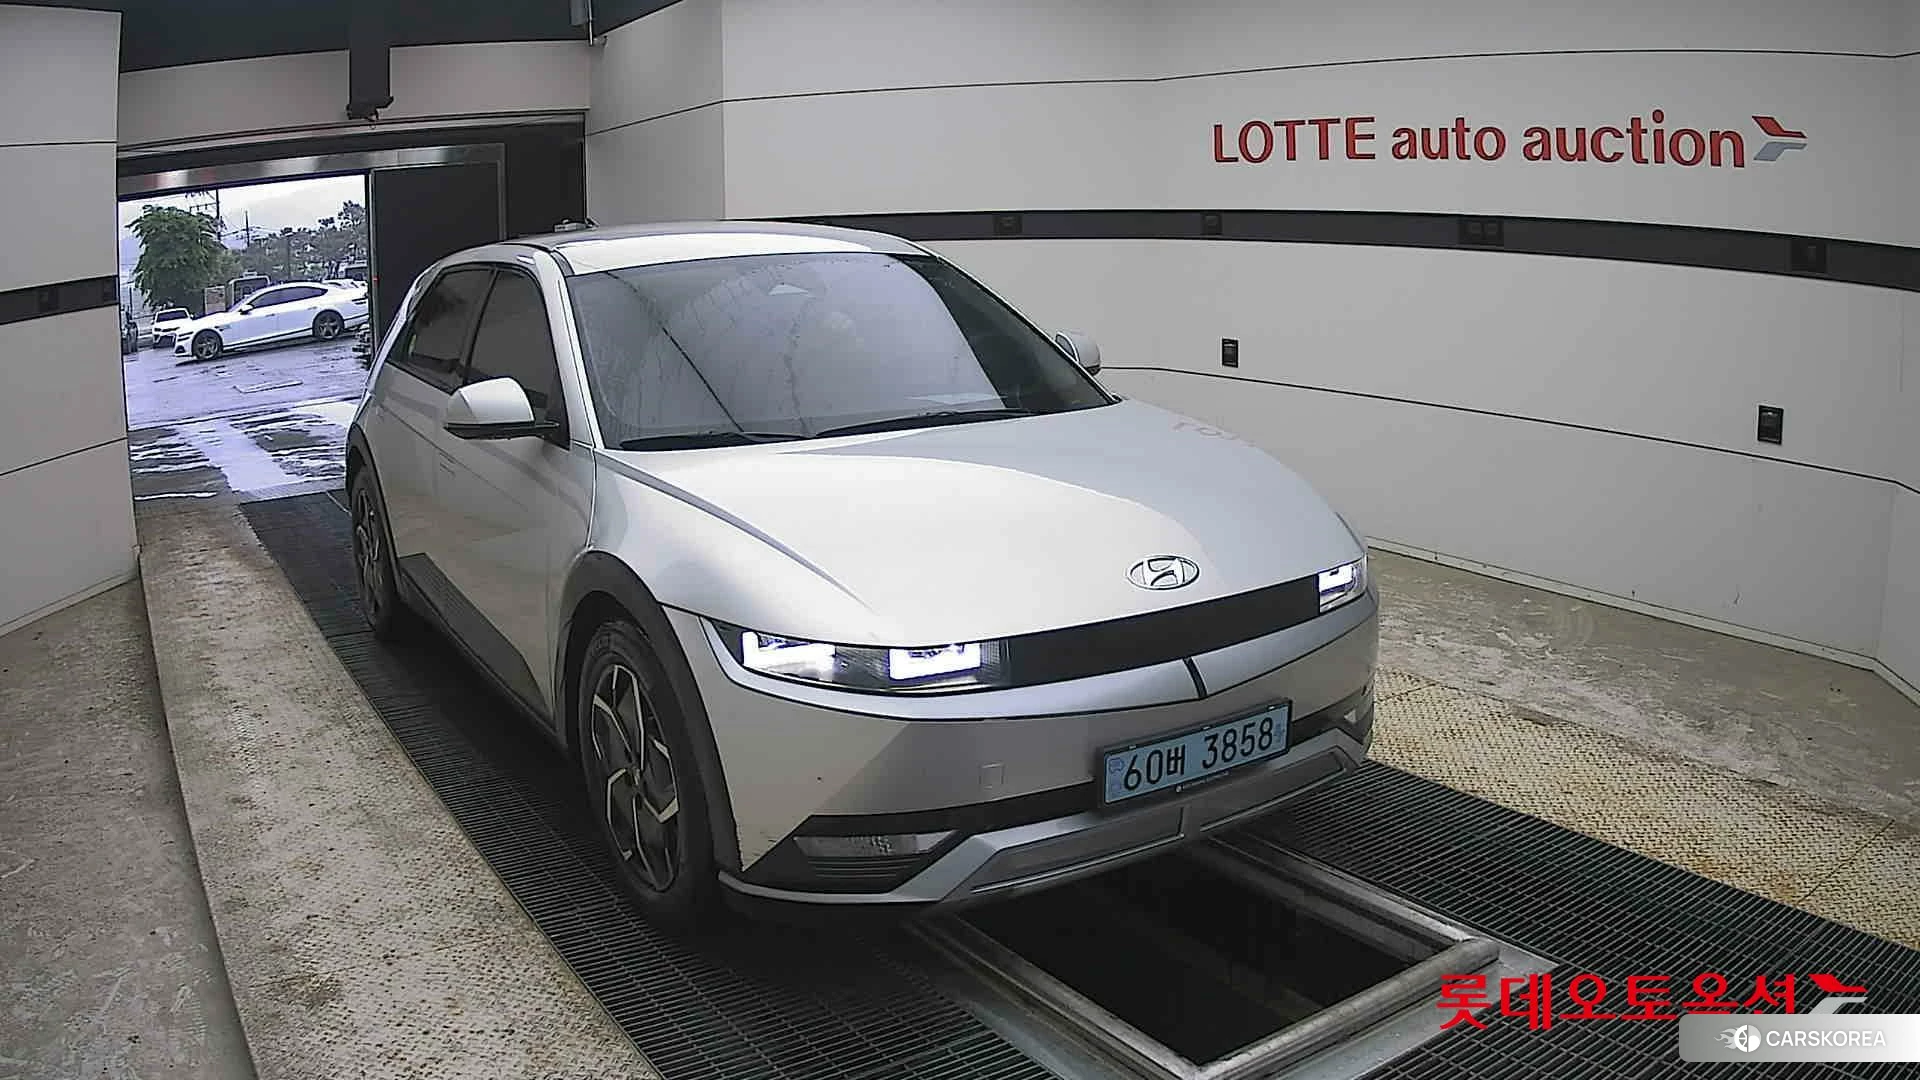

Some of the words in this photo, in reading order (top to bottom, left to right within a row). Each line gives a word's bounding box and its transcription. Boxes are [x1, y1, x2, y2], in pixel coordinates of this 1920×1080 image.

[1213, 116, 1376, 163] LOTTE
[1391, 117, 1507, 161] auto
[1522, 109, 1746, 168] auction
[1123, 744, 1186, 791] 60버
[1202, 717, 1273, 769] 3858
